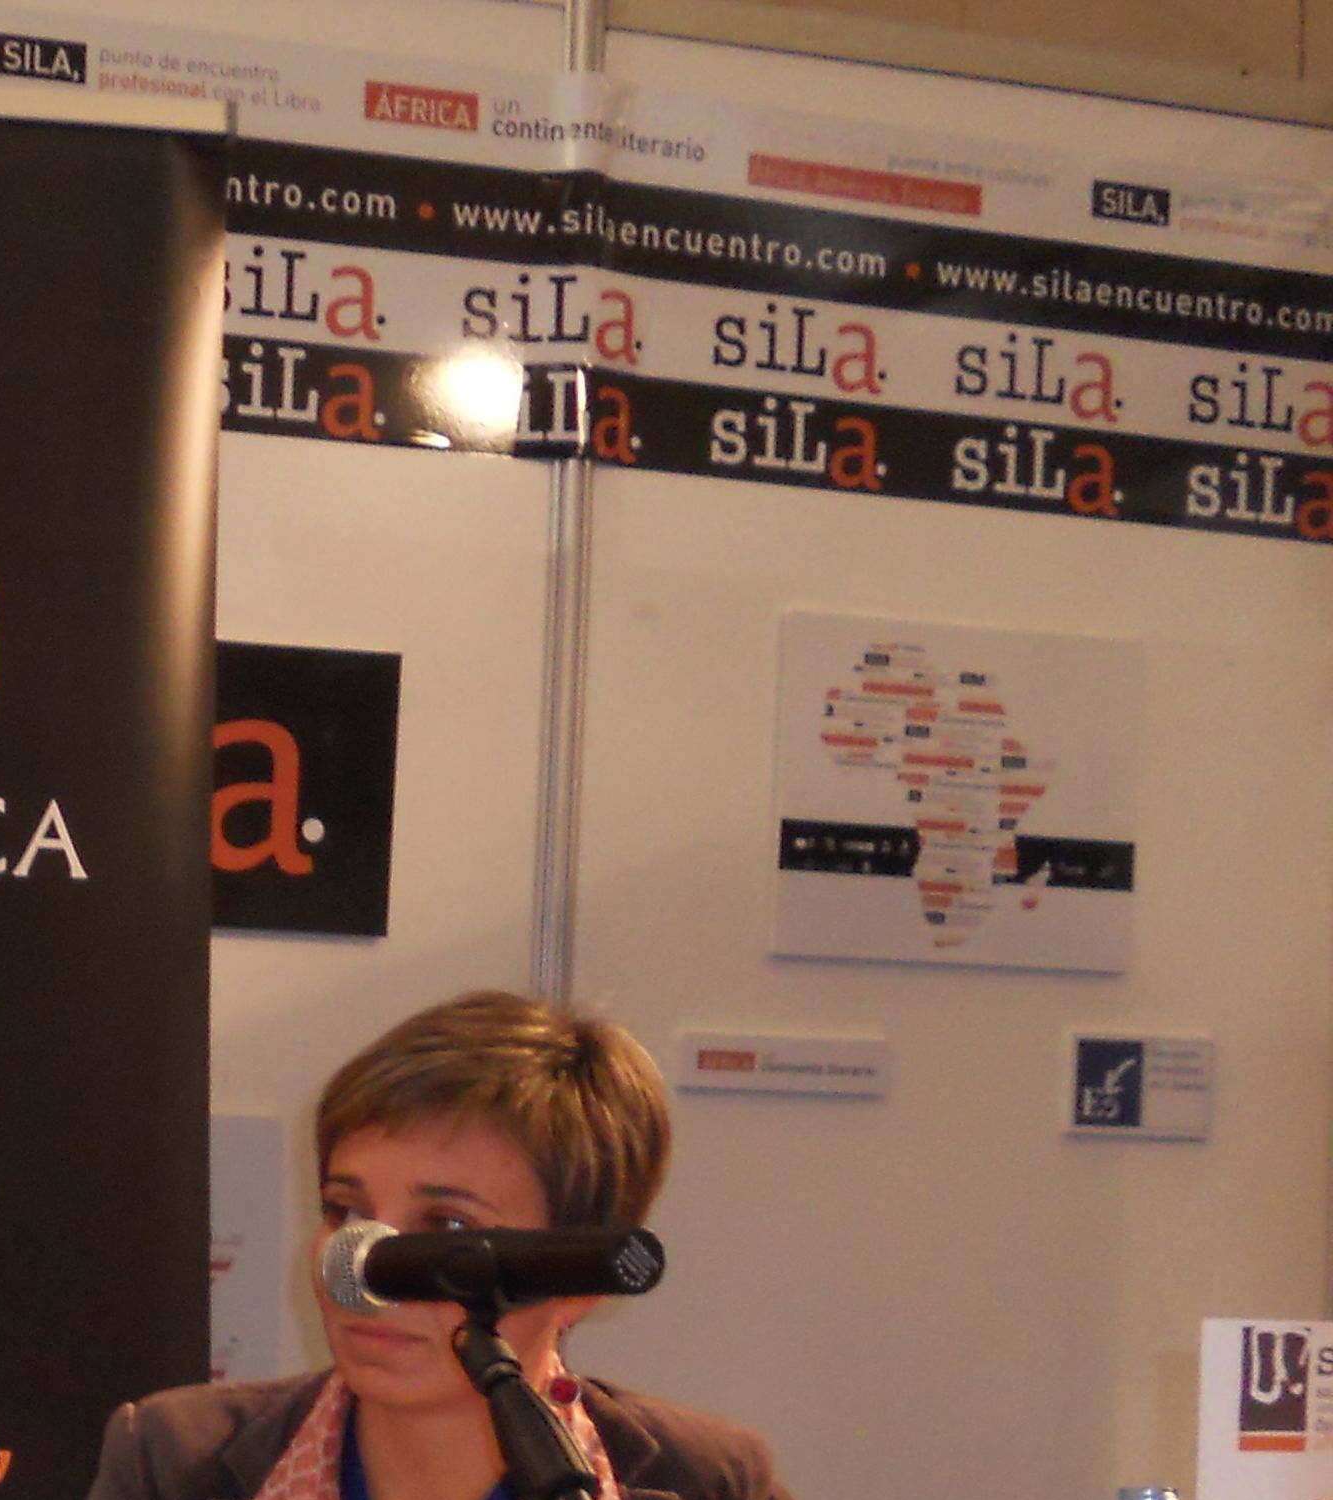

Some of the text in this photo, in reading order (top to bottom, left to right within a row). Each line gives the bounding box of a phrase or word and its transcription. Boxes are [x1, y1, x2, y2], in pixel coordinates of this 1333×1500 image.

[1, 39, 82, 81] SILA,
[157, 52, 182, 71] de
[374, 92, 471, 129] ÁFRICA
[493, 99, 520, 116] un
[713, 303, 887, 396] siLa.
[954, 332, 1124, 423] siLa.
[952, 425, 1124, 517] siLa.
